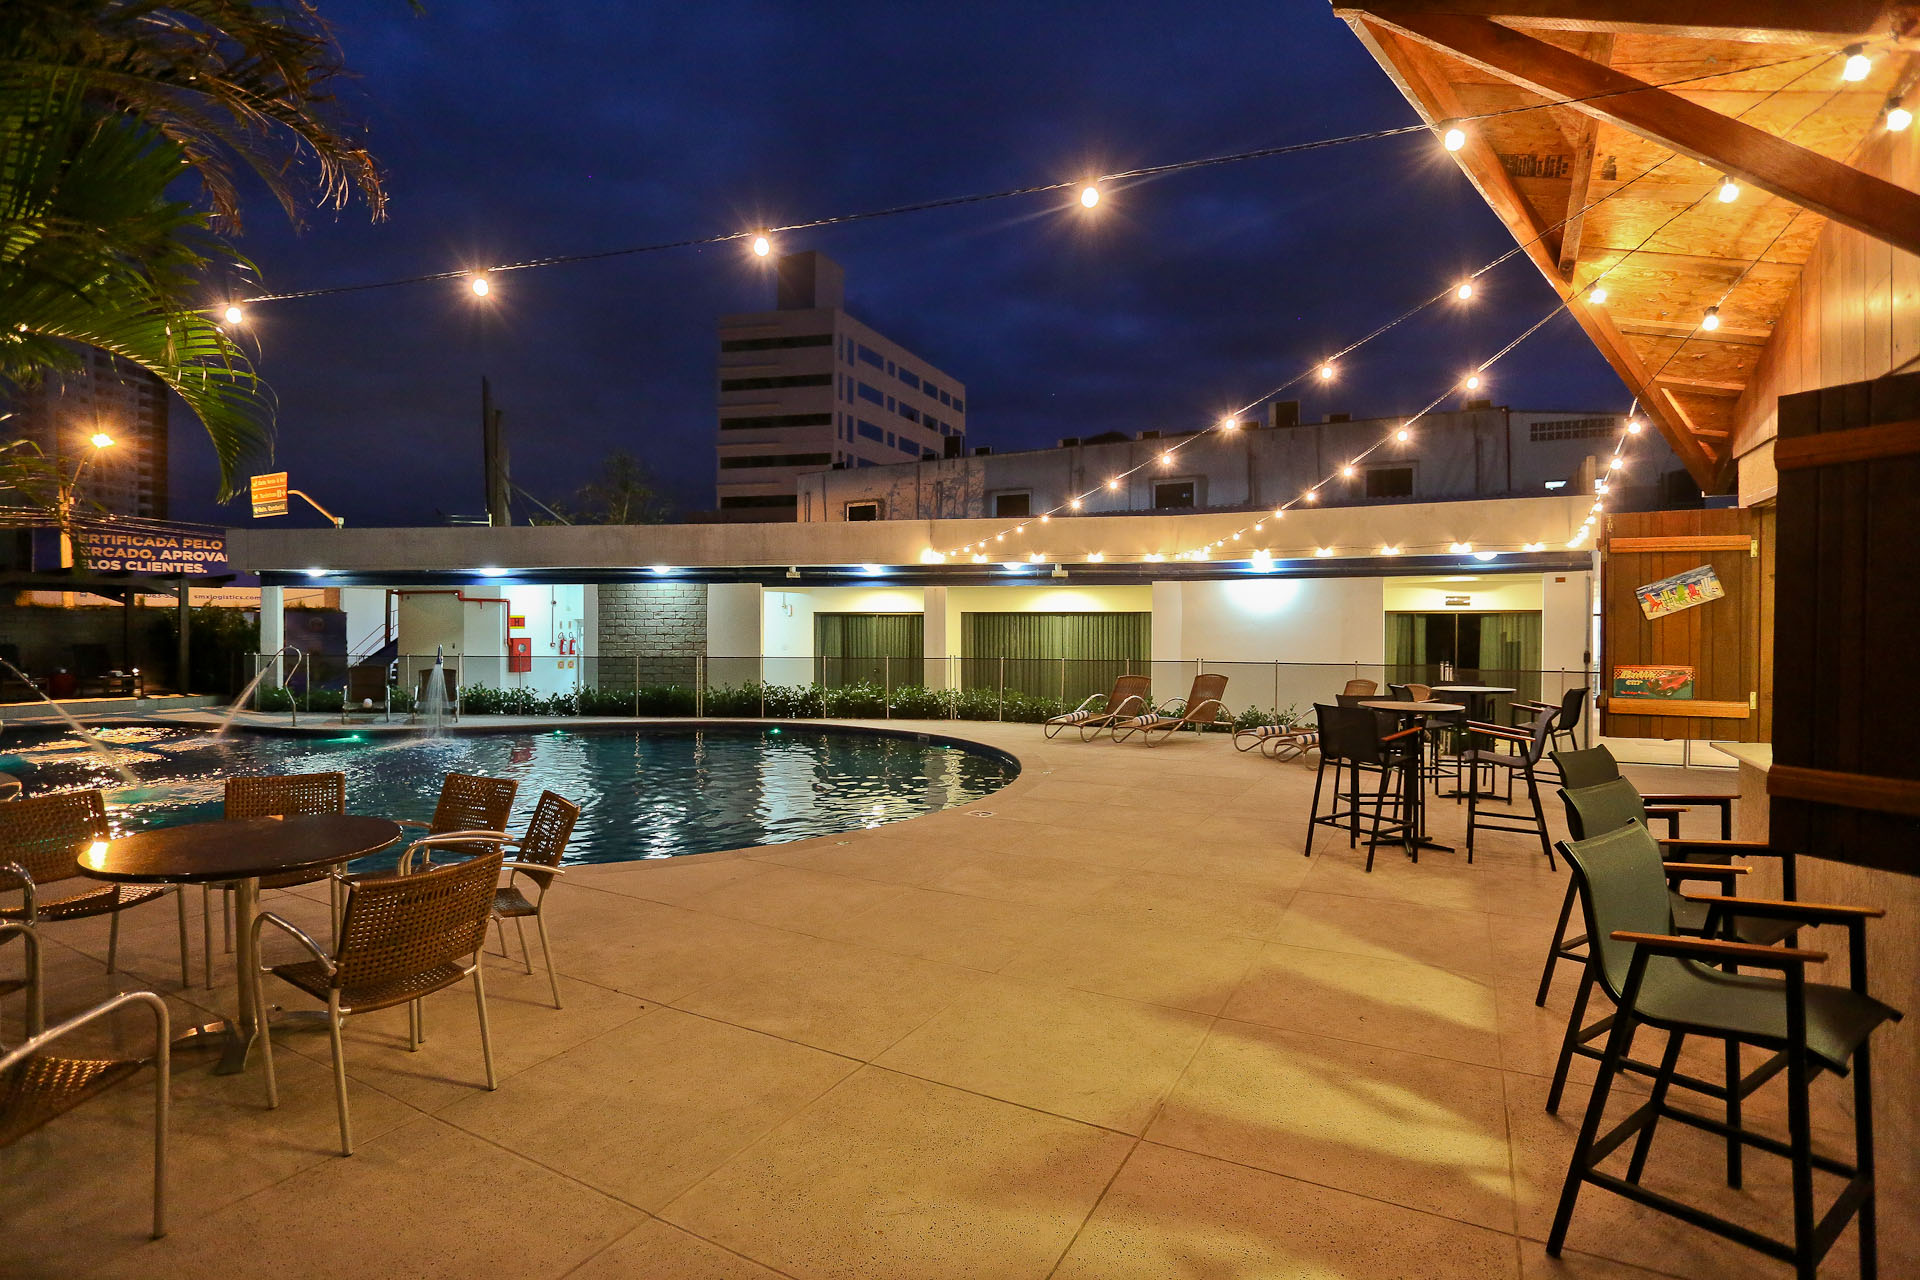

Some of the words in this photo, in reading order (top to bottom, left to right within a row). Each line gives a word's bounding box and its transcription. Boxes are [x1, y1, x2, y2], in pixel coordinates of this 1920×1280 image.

[77, 533, 180, 549] ERTIFICADA
[182, 538, 223, 550] PELO
[80, 546, 157, 561] RCADO,
[160, 550, 228, 562] APROVA
[81, 559, 121, 571] ELOS
[125, 561, 208, 574] CLIENTES.
[193, 593, 262, 601] smxlogistics.com
